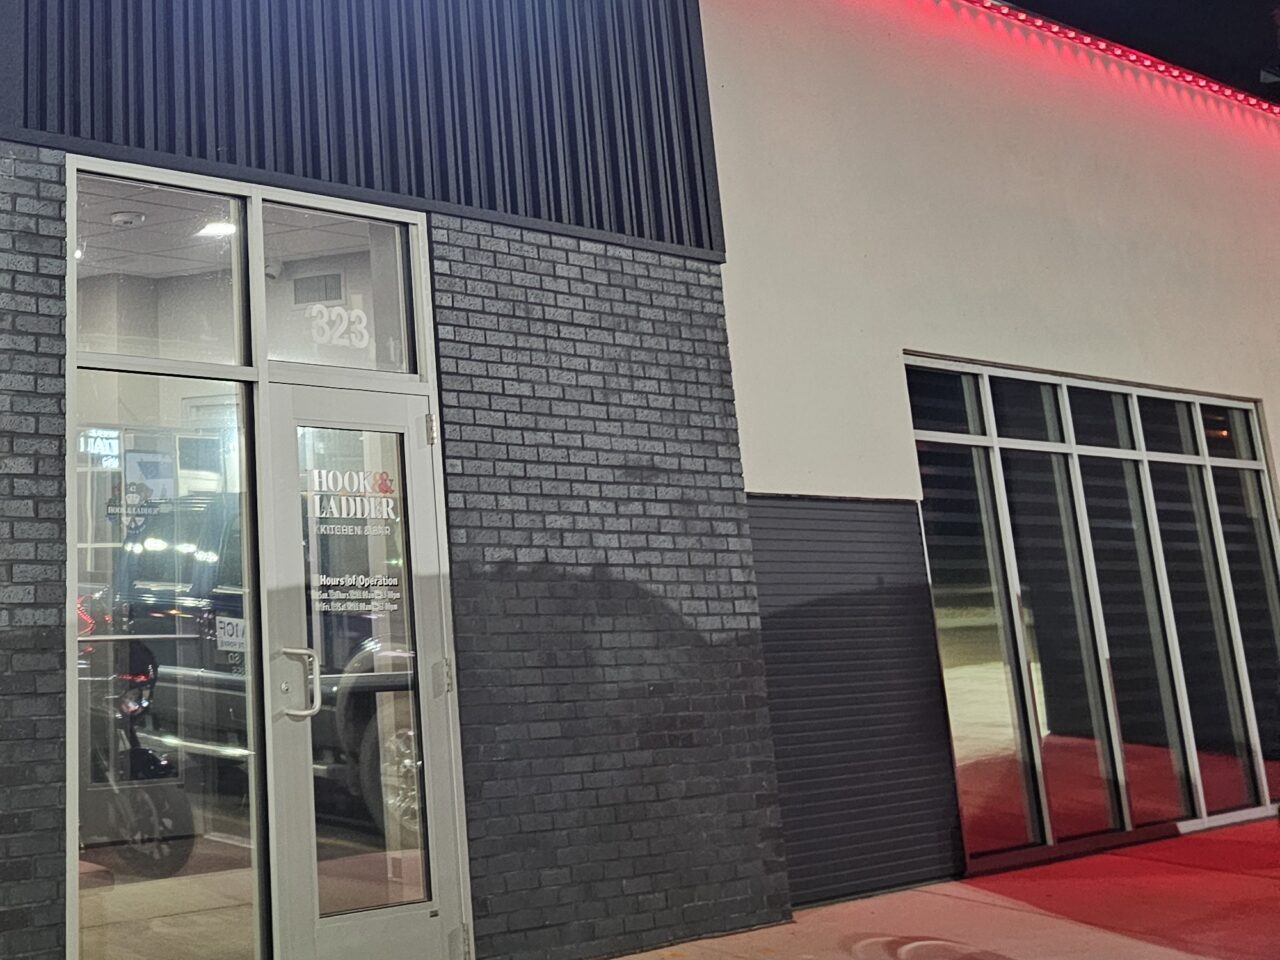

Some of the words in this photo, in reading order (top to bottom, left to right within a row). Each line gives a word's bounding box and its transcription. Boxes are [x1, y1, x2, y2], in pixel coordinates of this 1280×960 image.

[313, 469, 372, 493] HOOK
[314, 495, 396, 519] LADDER
[320, 524, 362, 536] KITCHEN
[320, 574, 345, 586] Hours
[347, 574, 357, 586] of
[359, 574, 399, 588] Operation
